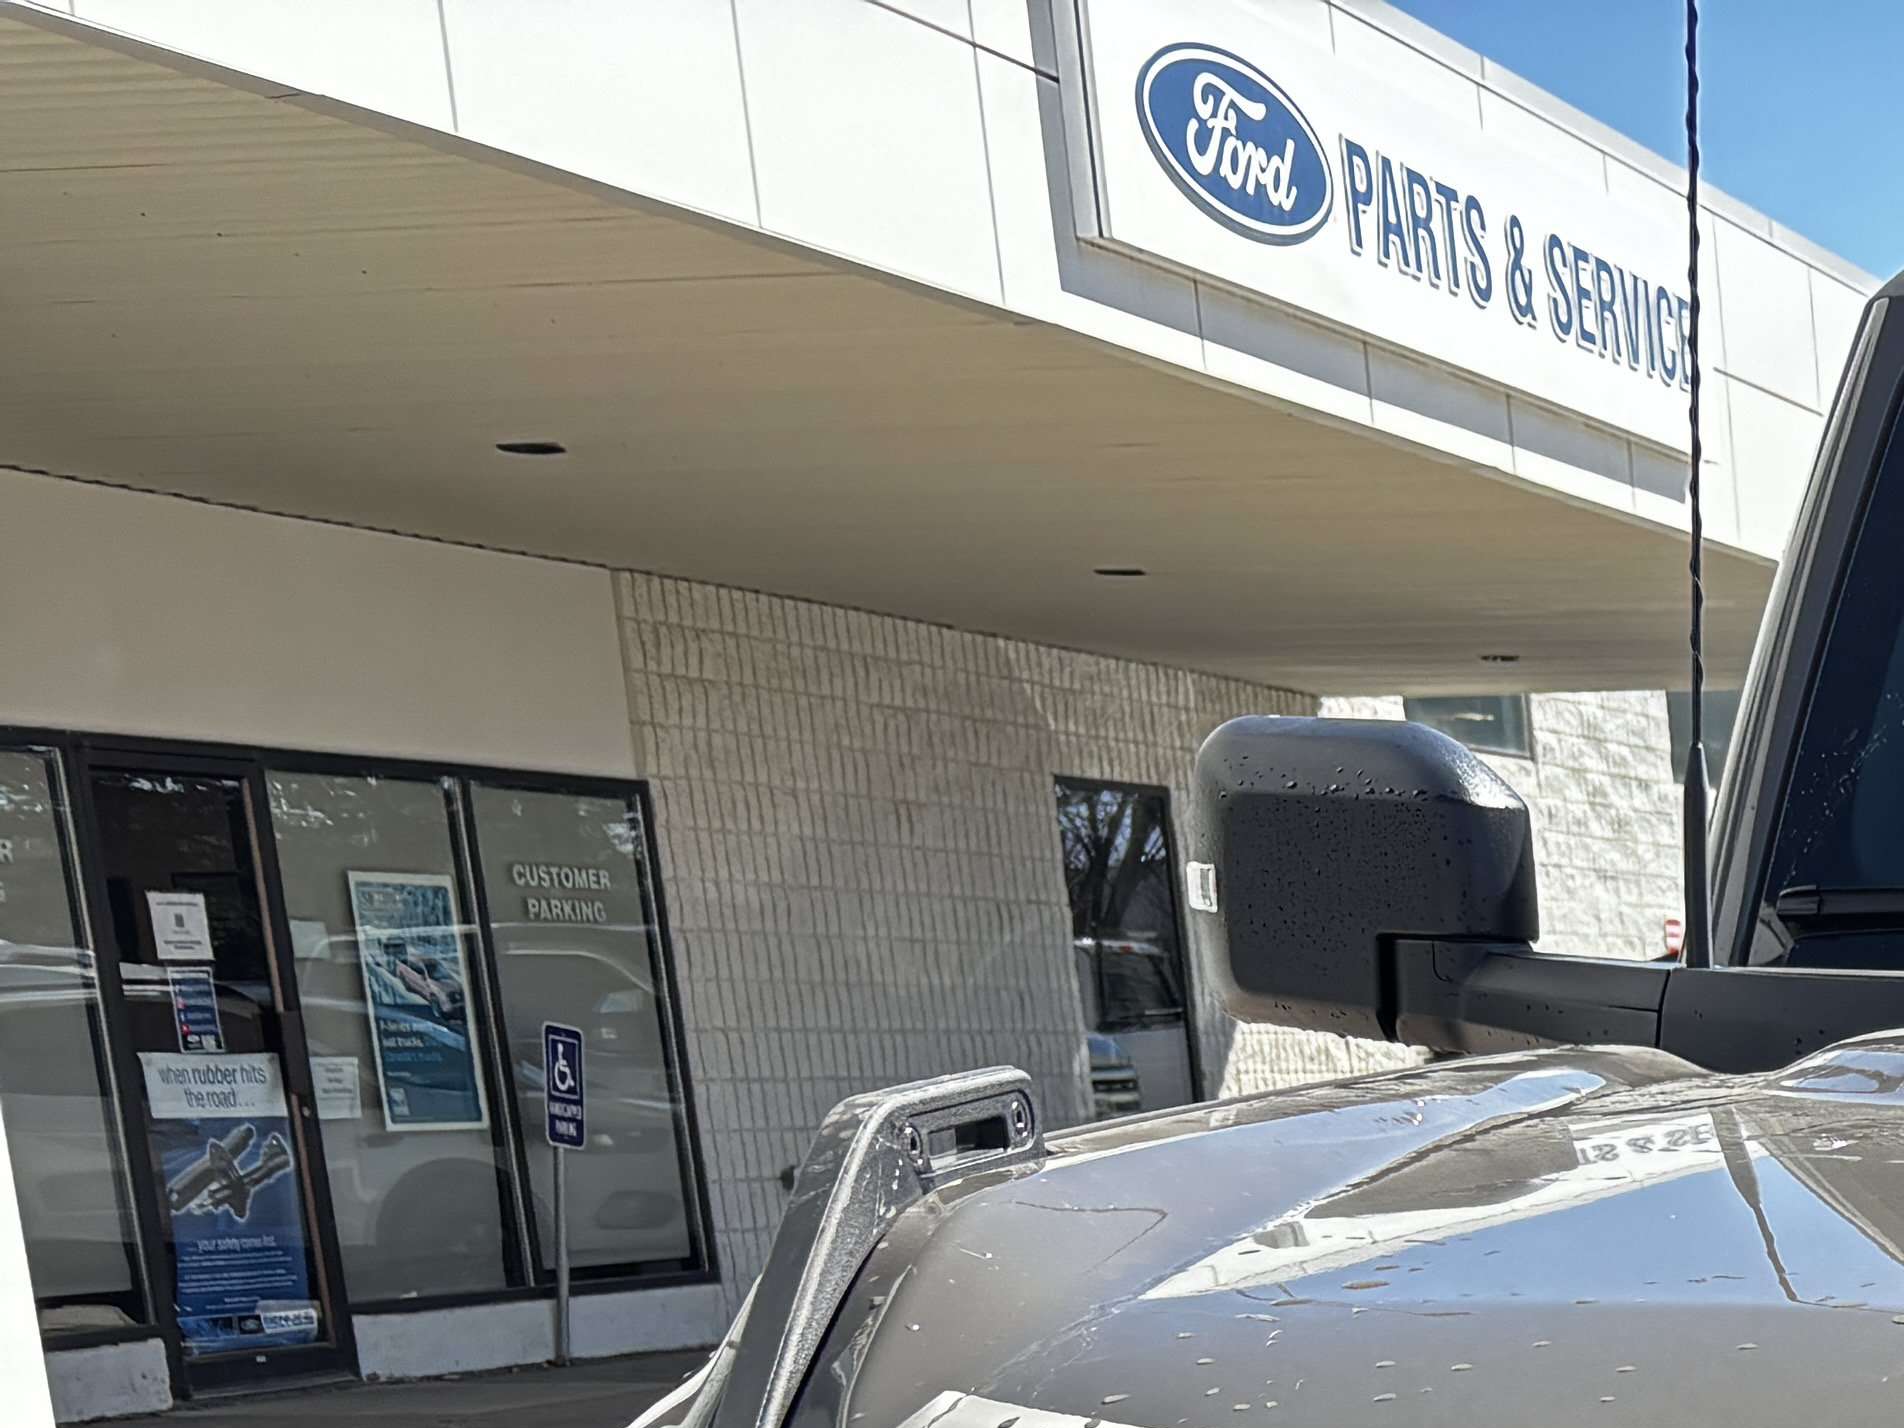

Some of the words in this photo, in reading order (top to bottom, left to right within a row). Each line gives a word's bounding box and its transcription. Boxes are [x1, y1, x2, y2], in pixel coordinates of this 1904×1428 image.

[1186, 72, 1298, 211] Ford
[1340, 134, 1493, 309] PARTS
[1504, 214, 1538, 330] &
[512, 864, 611, 890] CUSTOMER
[527, 898, 607, 922] PARKING
[157, 1066, 190, 1085] when
[191, 1064, 238, 1085] rubber
[240, 1063, 268, 1084] hits
[184, 1088, 206, 1109] the
